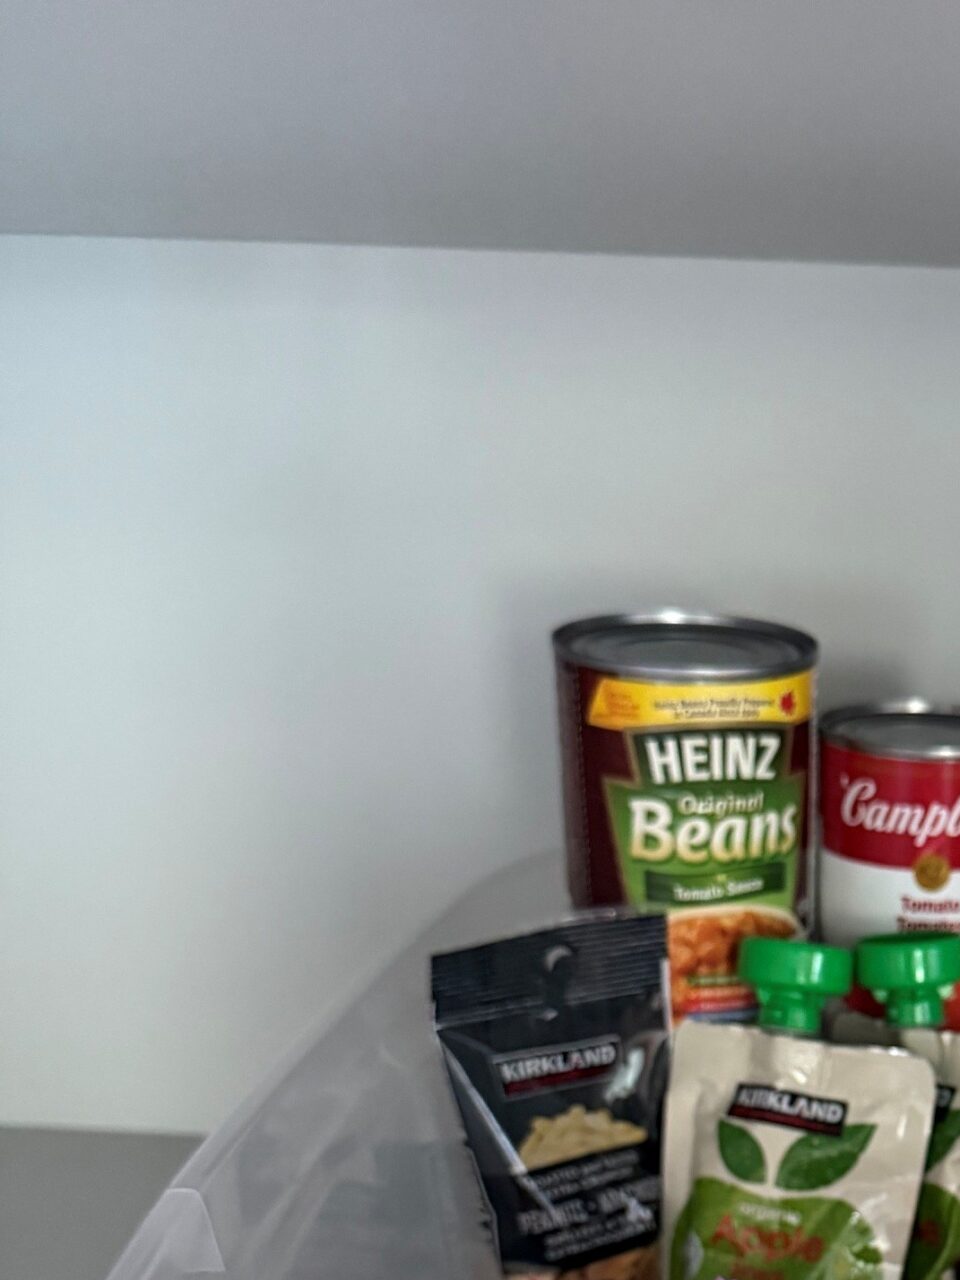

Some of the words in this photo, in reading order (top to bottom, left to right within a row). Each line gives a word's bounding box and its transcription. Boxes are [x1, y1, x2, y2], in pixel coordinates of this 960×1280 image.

[645, 731, 781, 785] HEINZ
[677, 790, 763, 818] Original
[628, 795, 797, 863] Beans
[500, 1043, 618, 1084] KIRKLAND
[736, 1087, 844, 1126] KIRKLAND
